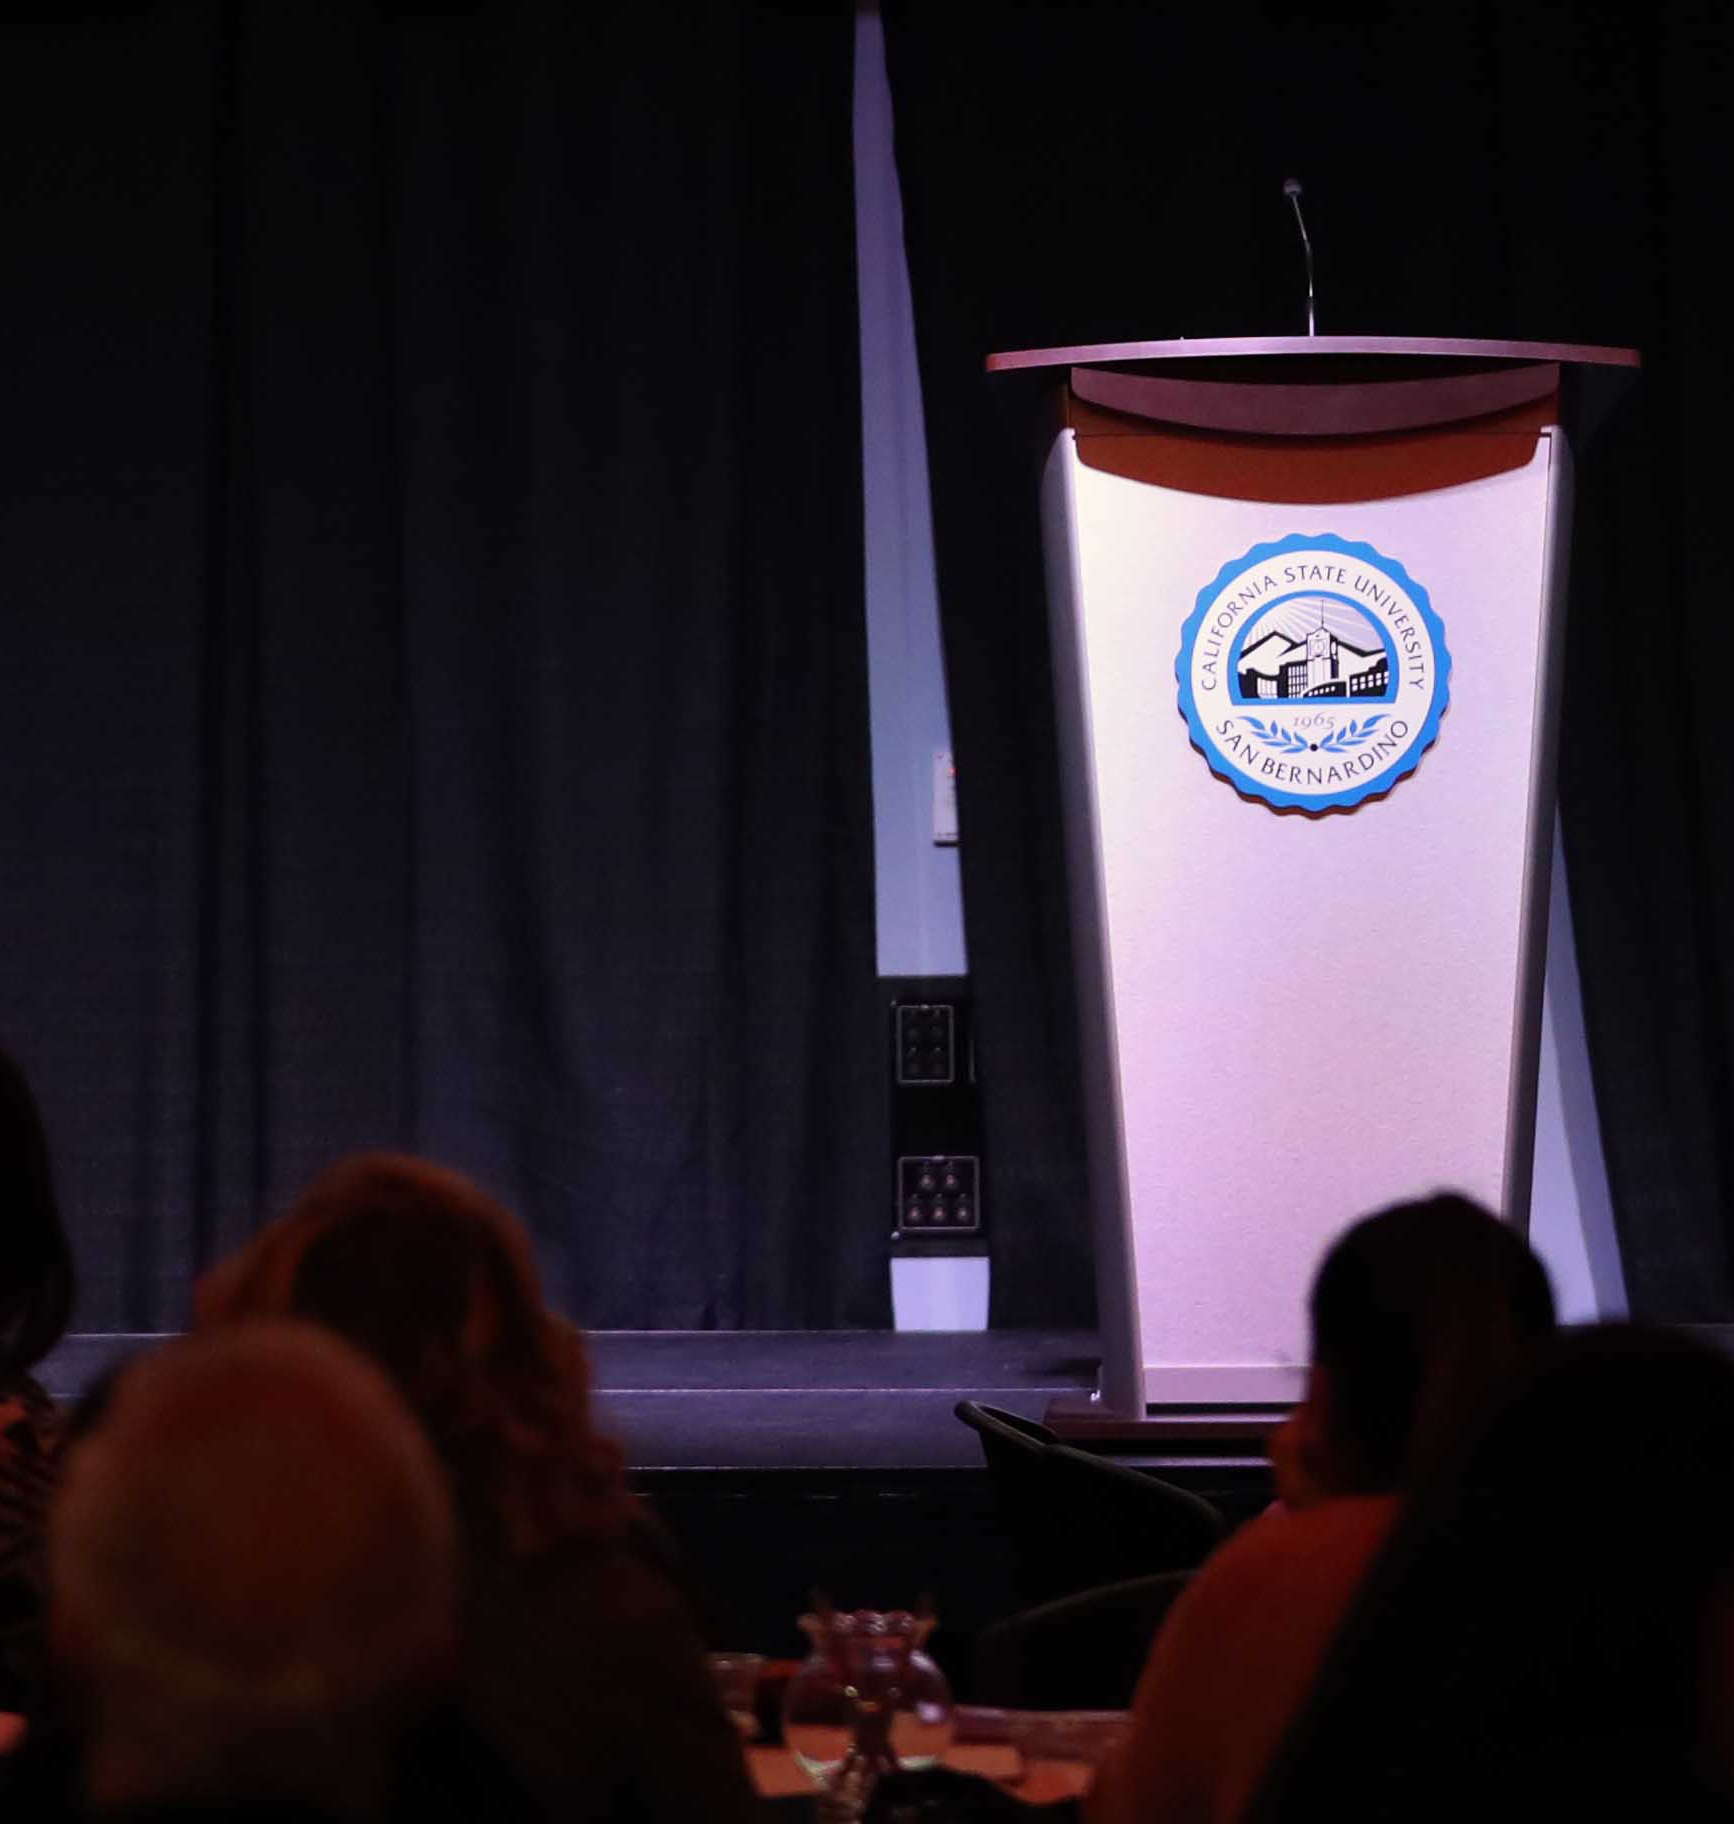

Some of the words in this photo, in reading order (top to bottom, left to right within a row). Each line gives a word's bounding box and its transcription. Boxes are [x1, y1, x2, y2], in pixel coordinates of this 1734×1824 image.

[1201, 575, 1279, 692] CALIFORNIA
[1283, 564, 1348, 585] STATE
[1353, 575, 1426, 691] UNIVERSITY
[1215, 718, 1263, 766] SAN
[1260, 719, 1410, 786] BERNARDINO
[1292, 712, 1337, 730] 1965
